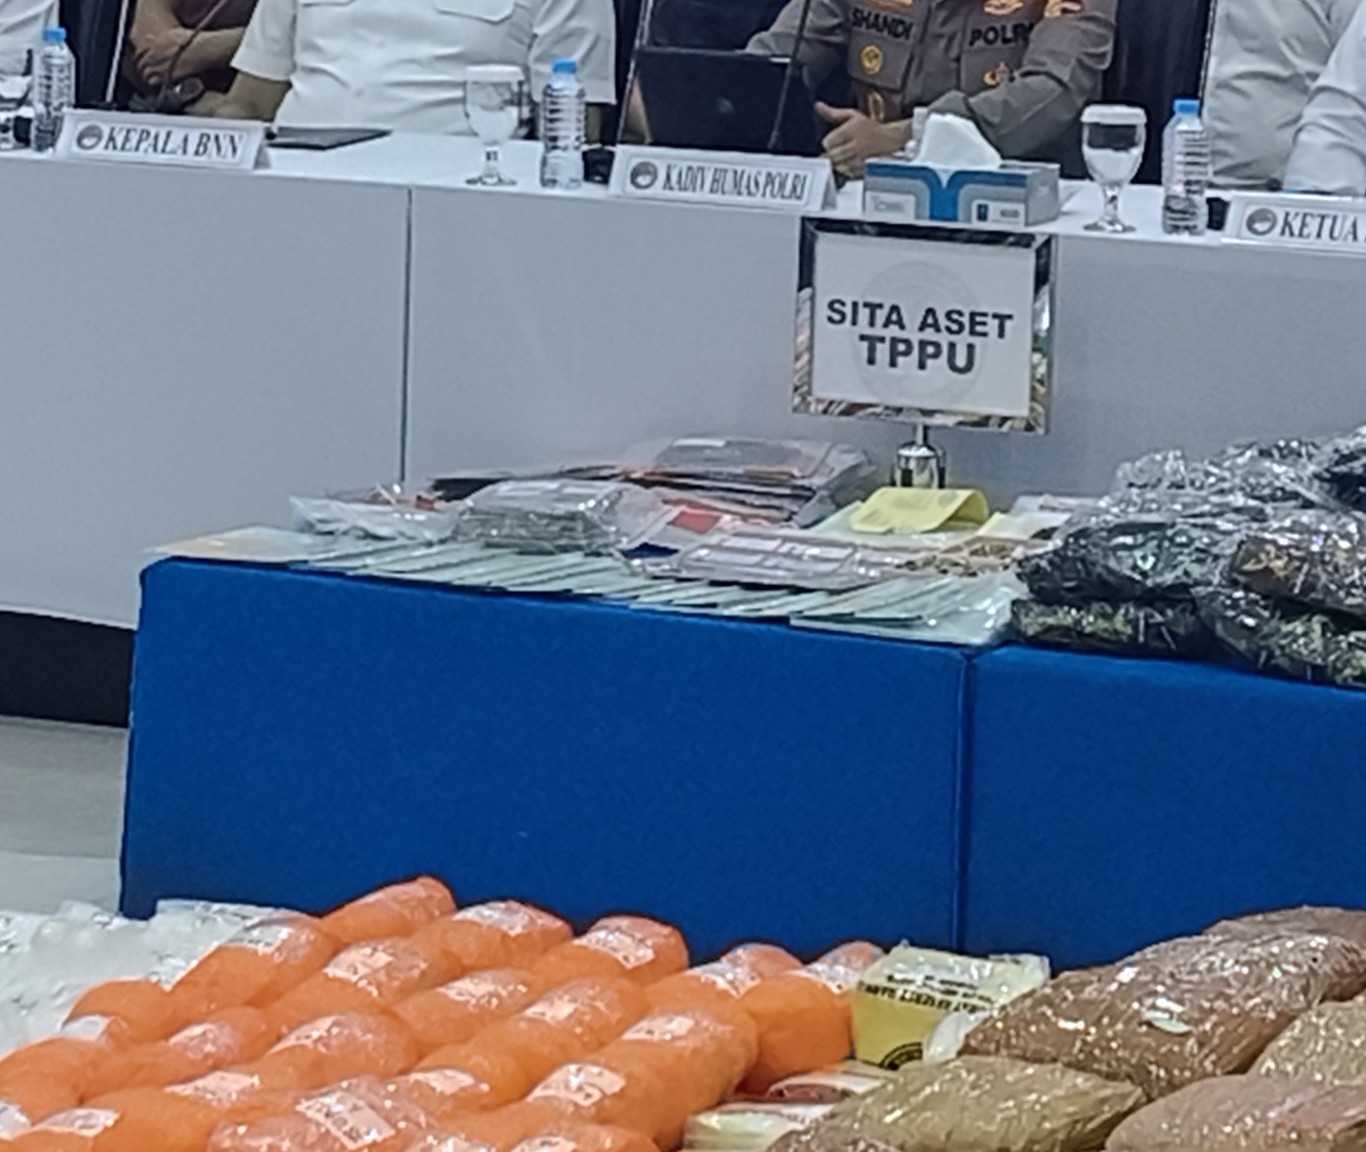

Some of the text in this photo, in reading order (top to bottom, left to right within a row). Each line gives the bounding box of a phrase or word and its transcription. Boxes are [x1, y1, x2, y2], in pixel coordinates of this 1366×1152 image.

[104, 126, 243, 160] KEPALA BNN
[662, 163, 809, 202] KADIV HUMAS POLRI
[1278, 209, 1359, 243] KETUA
[826, 298, 1014, 339] SITA ASET
[858, 334, 976, 375] TPPU
